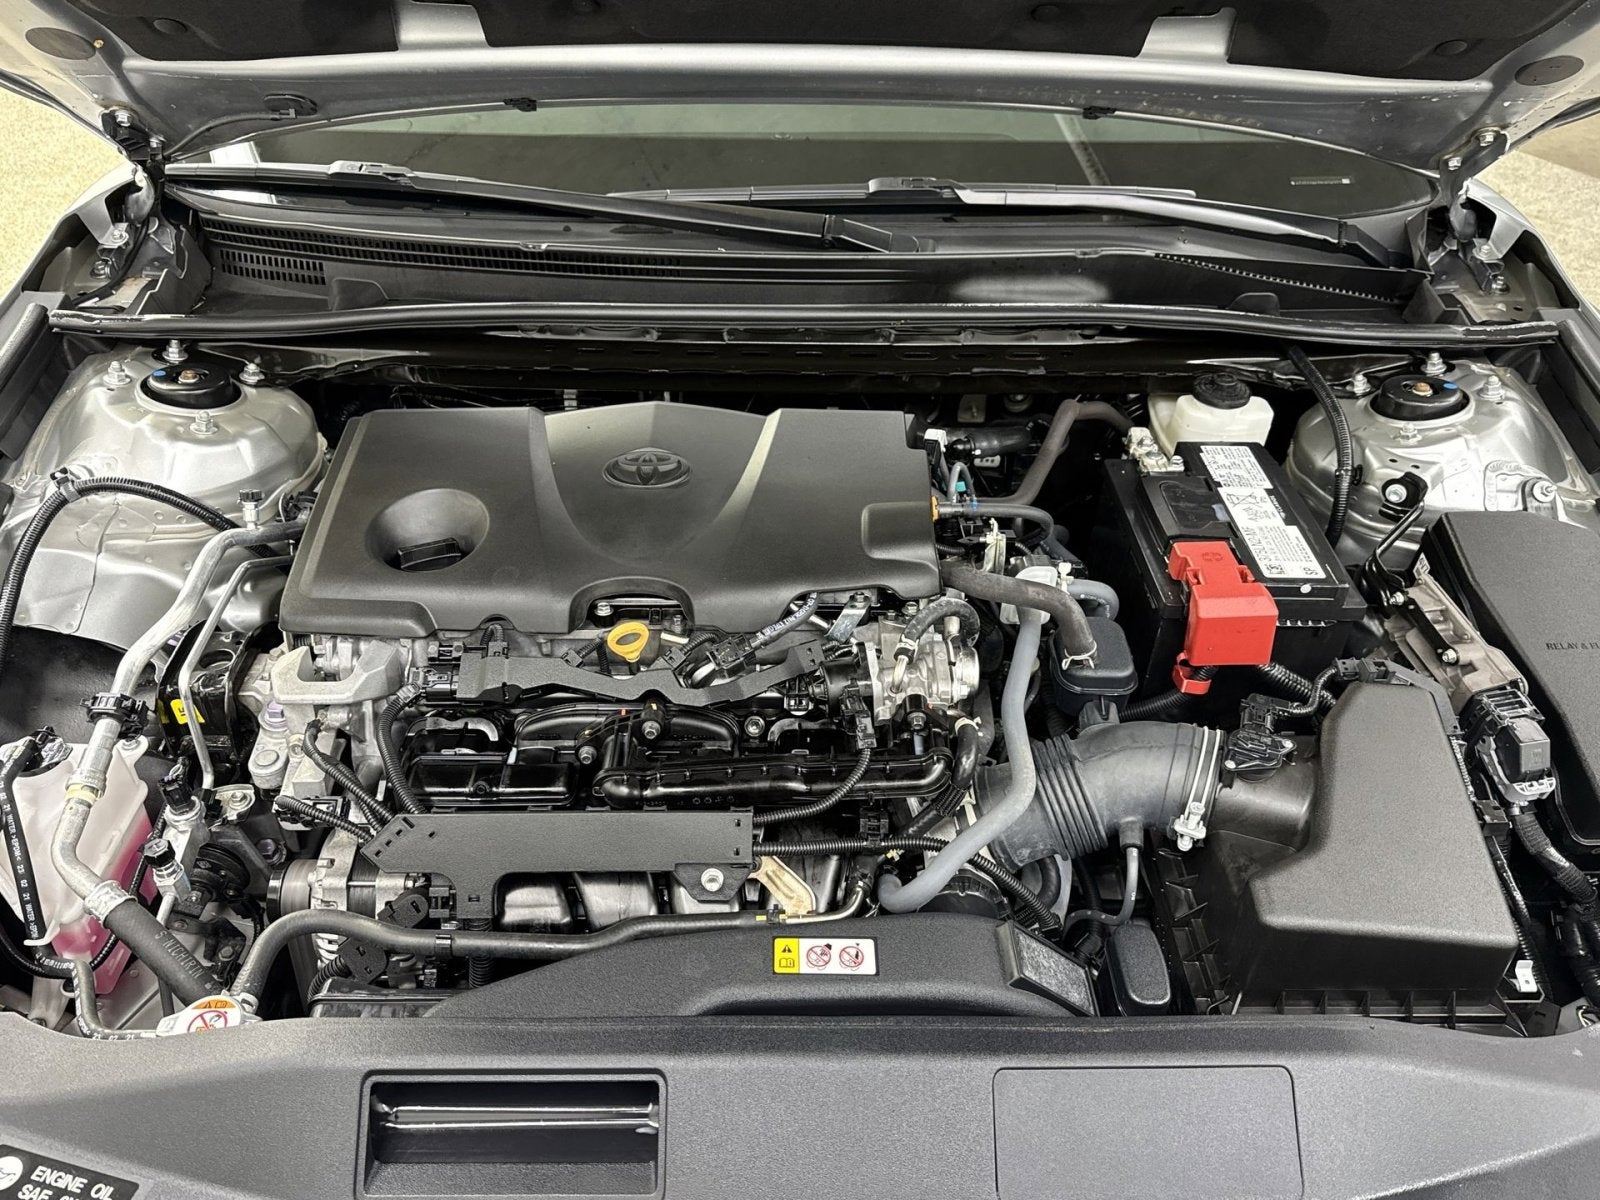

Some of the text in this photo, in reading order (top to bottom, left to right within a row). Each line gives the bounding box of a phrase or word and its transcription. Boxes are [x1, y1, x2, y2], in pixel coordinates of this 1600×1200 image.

[1545, 642, 1578, 650] RELAY
[6, 813, 16, 834] WATER
[24, 902, 36, 922] WATER
[162, 939, 205, 979] NICHIRIN
[30, 1165, 115, 1200] ENGINE OIL
